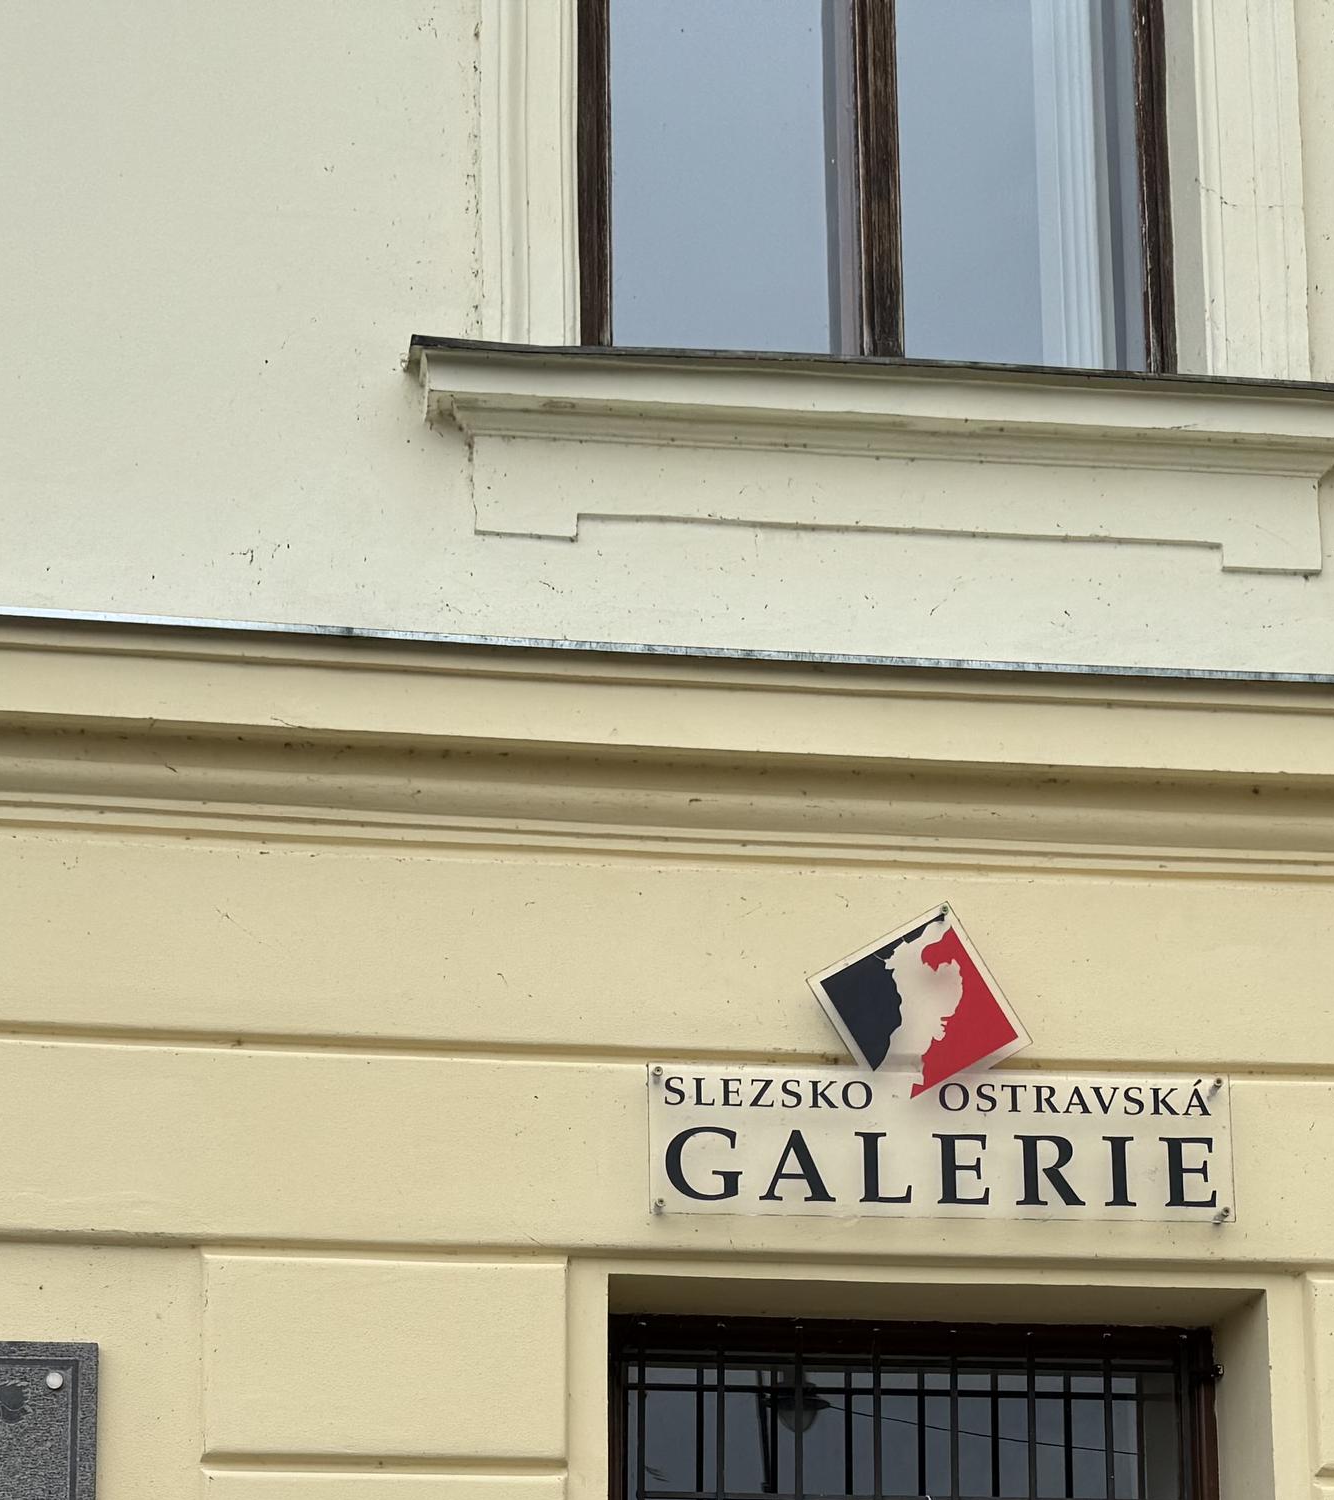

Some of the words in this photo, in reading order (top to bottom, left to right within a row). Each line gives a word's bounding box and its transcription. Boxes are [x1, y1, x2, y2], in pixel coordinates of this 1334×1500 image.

[664, 1076, 873, 1111] SLEZSKO
[938, 1079, 1212, 1117] OSTRAVSKÁ
[665, 1125, 1218, 1208] GALERIE
